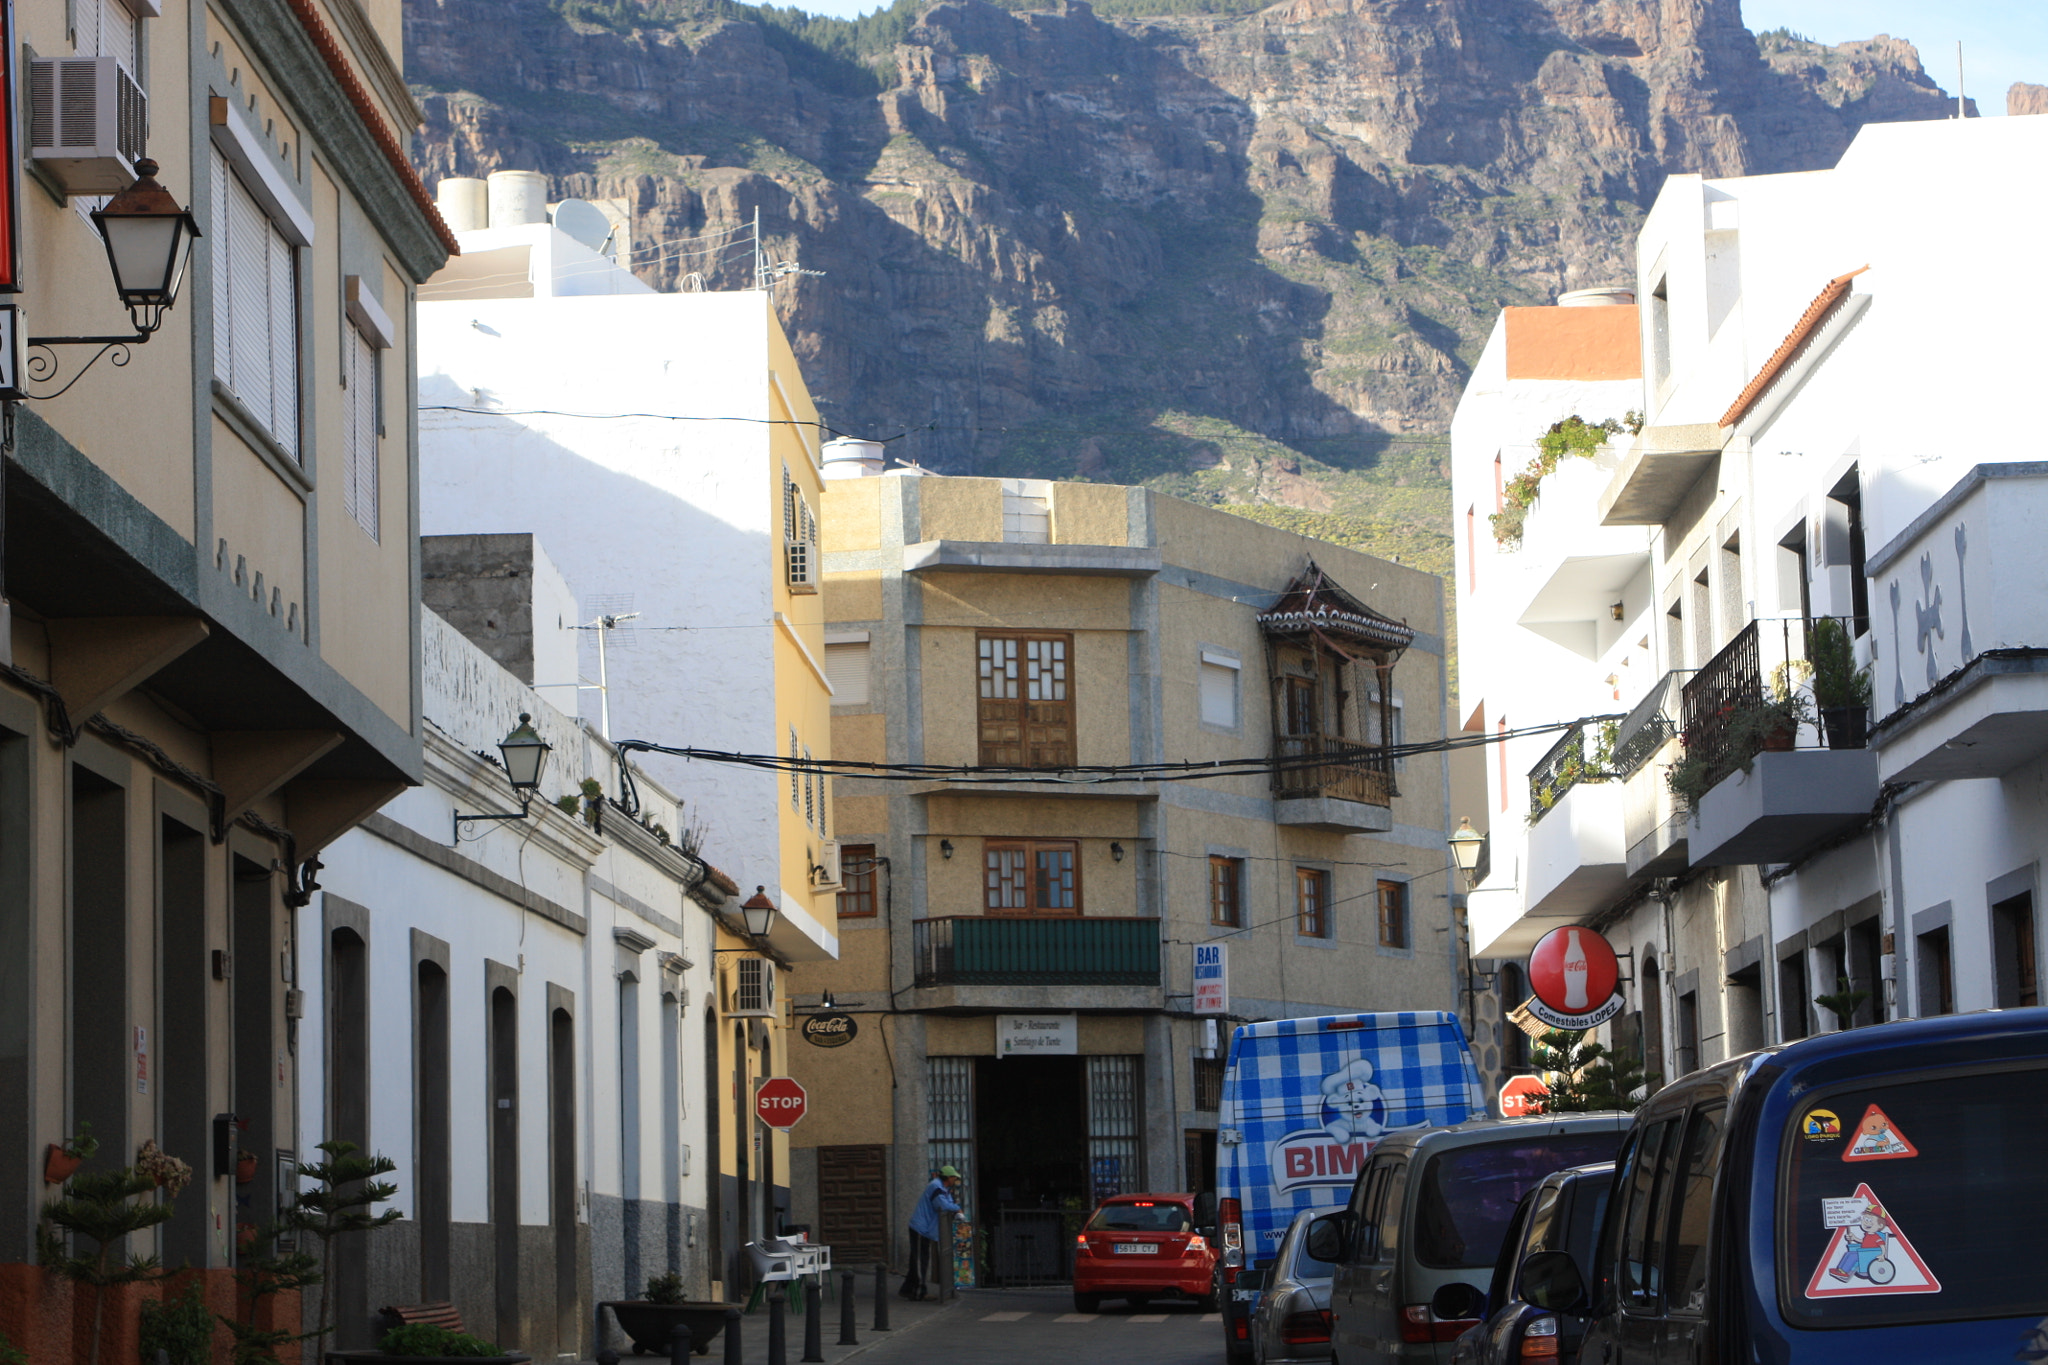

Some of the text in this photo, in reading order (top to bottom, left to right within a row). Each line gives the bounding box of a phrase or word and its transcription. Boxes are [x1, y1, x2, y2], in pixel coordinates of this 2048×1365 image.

[1197, 946, 1219, 965] BAR
[1538, 1002, 1617, 1027] Comestibles LOPEZ
[807, 1018, 848, 1033] Coca-Cola
[760, 1096, 802, 1109] STOP
[1285, 1141, 1378, 1178] BIM
